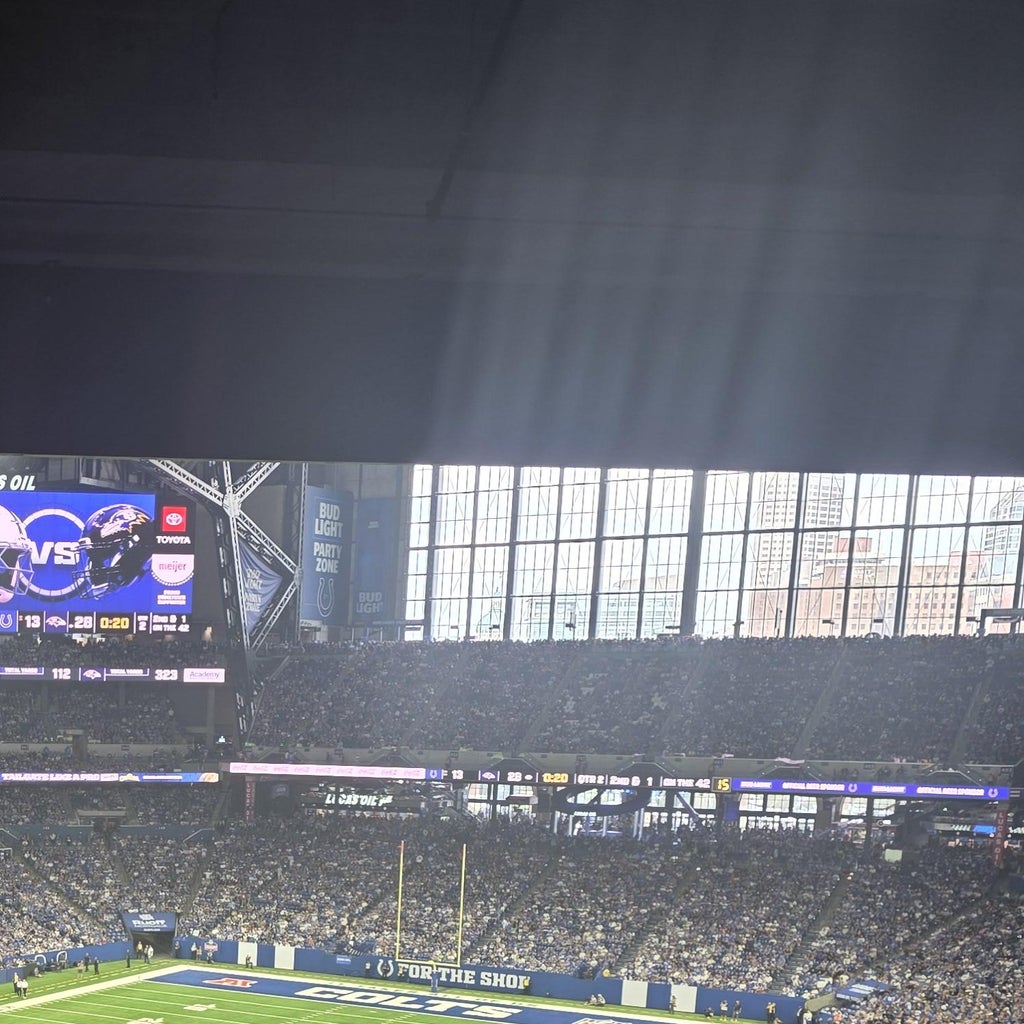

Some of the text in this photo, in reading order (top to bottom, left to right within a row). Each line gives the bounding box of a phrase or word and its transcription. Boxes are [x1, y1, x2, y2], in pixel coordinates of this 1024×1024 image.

[10, 475, 36, 491] OIL
[320, 502, 340, 521] BUD
[314, 518, 343, 538] LIGHT
[156, 536, 191, 544] TOYOTA
[30, 541, 79, 565] VS
[313, 541, 342, 559] PARTY
[159, 561, 187, 572] meijer
[316, 557, 338, 573] ZONE
[359, 591, 382, 605] BUD
[25, 615, 41, 628] 13
[100, 617, 129, 629] 0:20
[52, 669, 71, 680] 112
[189, 671, 220, 679] Academy
[647, 777, 653, 786] 1
[696, 778, 710, 788] 42
[397, 963, 432, 979] FOR
[439, 967, 476, 985] THE
[295, 987, 524, 1019] COLTS
